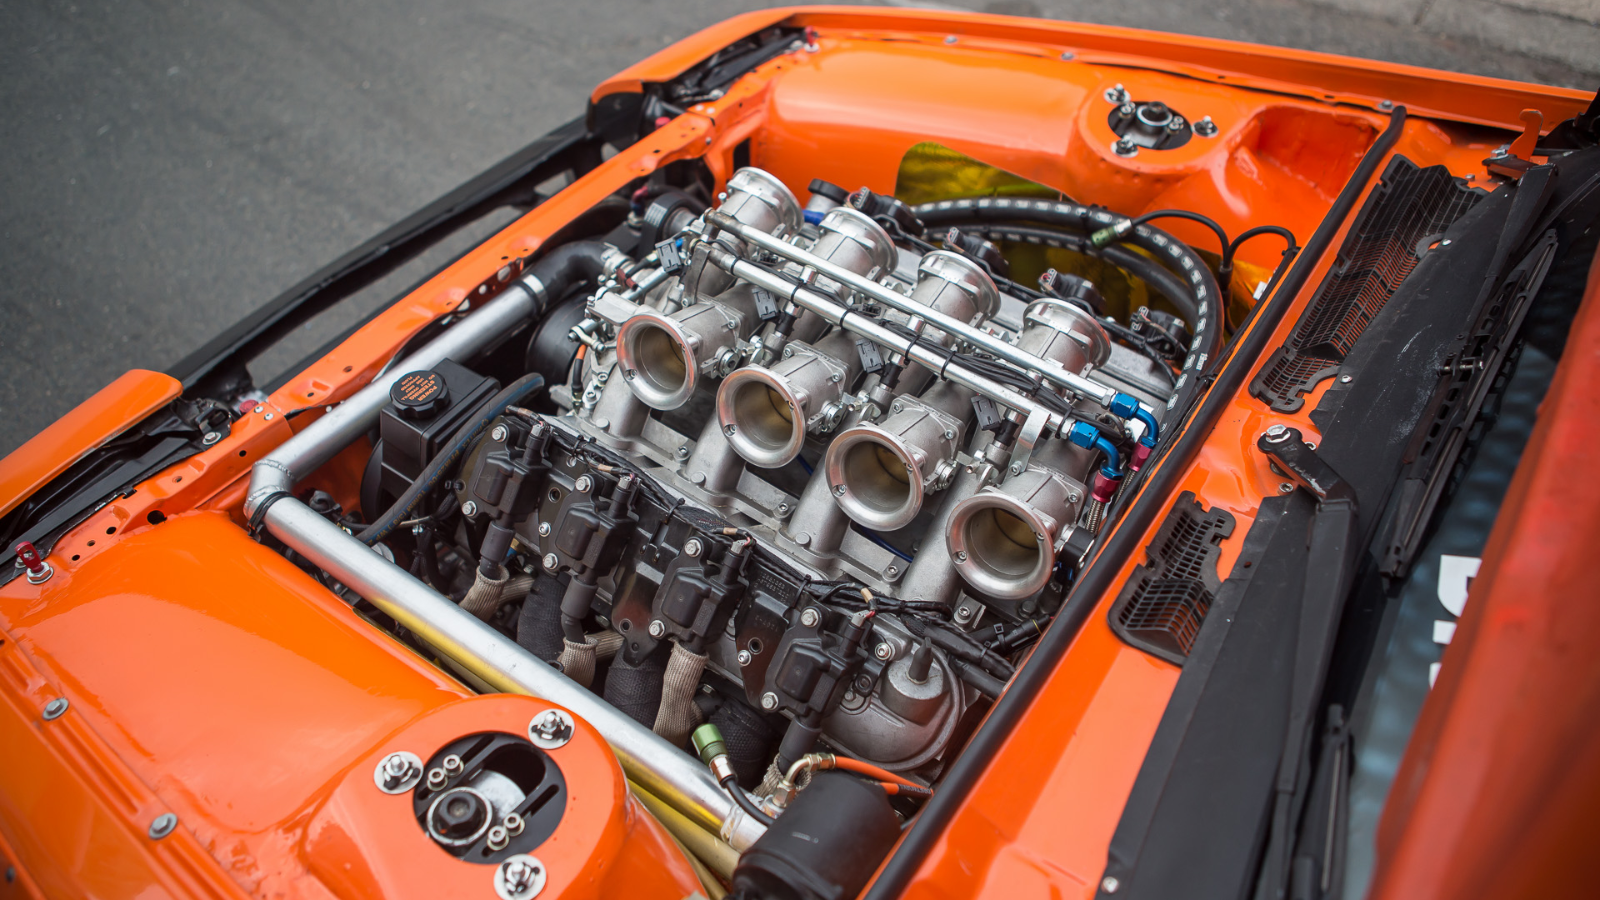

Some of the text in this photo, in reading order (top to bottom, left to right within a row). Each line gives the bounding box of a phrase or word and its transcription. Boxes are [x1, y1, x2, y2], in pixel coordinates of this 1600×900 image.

[400, 375, 420, 391] APPROVED
[409, 380, 435, 400] STEERING
[417, 385, 437, 401] POWER
